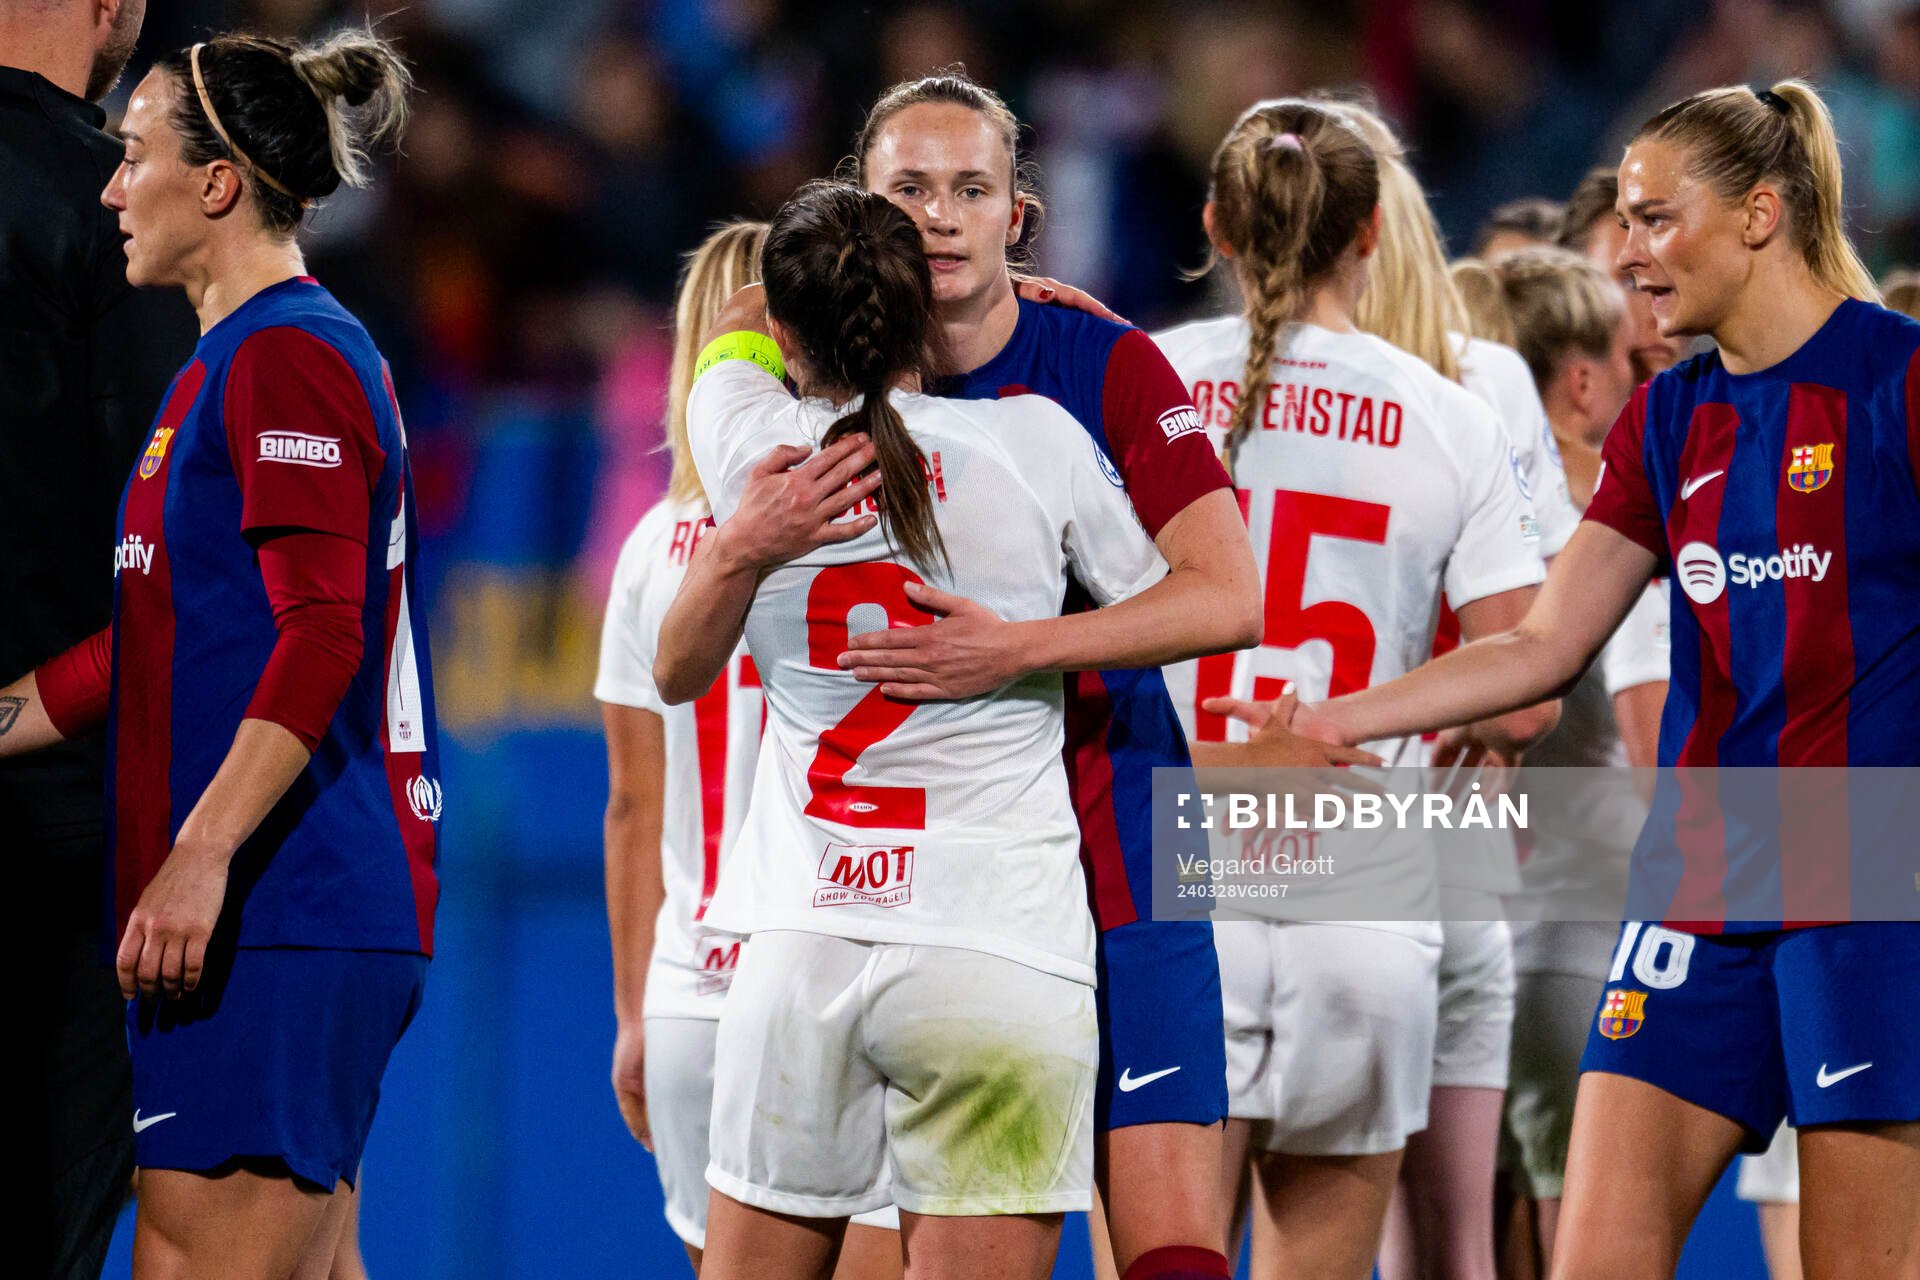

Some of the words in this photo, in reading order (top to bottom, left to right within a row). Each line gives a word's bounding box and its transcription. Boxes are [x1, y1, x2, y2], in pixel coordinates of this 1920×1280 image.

[1160, 410, 1203, 438] BIM
[1192, 379, 1404, 449] ØSENSTAD
[259, 436, 342, 463] BIMBO
[1728, 543, 1832, 589] Spotify
[830, 846, 914, 889] MOT
[820, 891, 849, 902] SHOW
[853, 892, 904, 905] COURAGE!
[1608, 921, 1696, 990] 10
